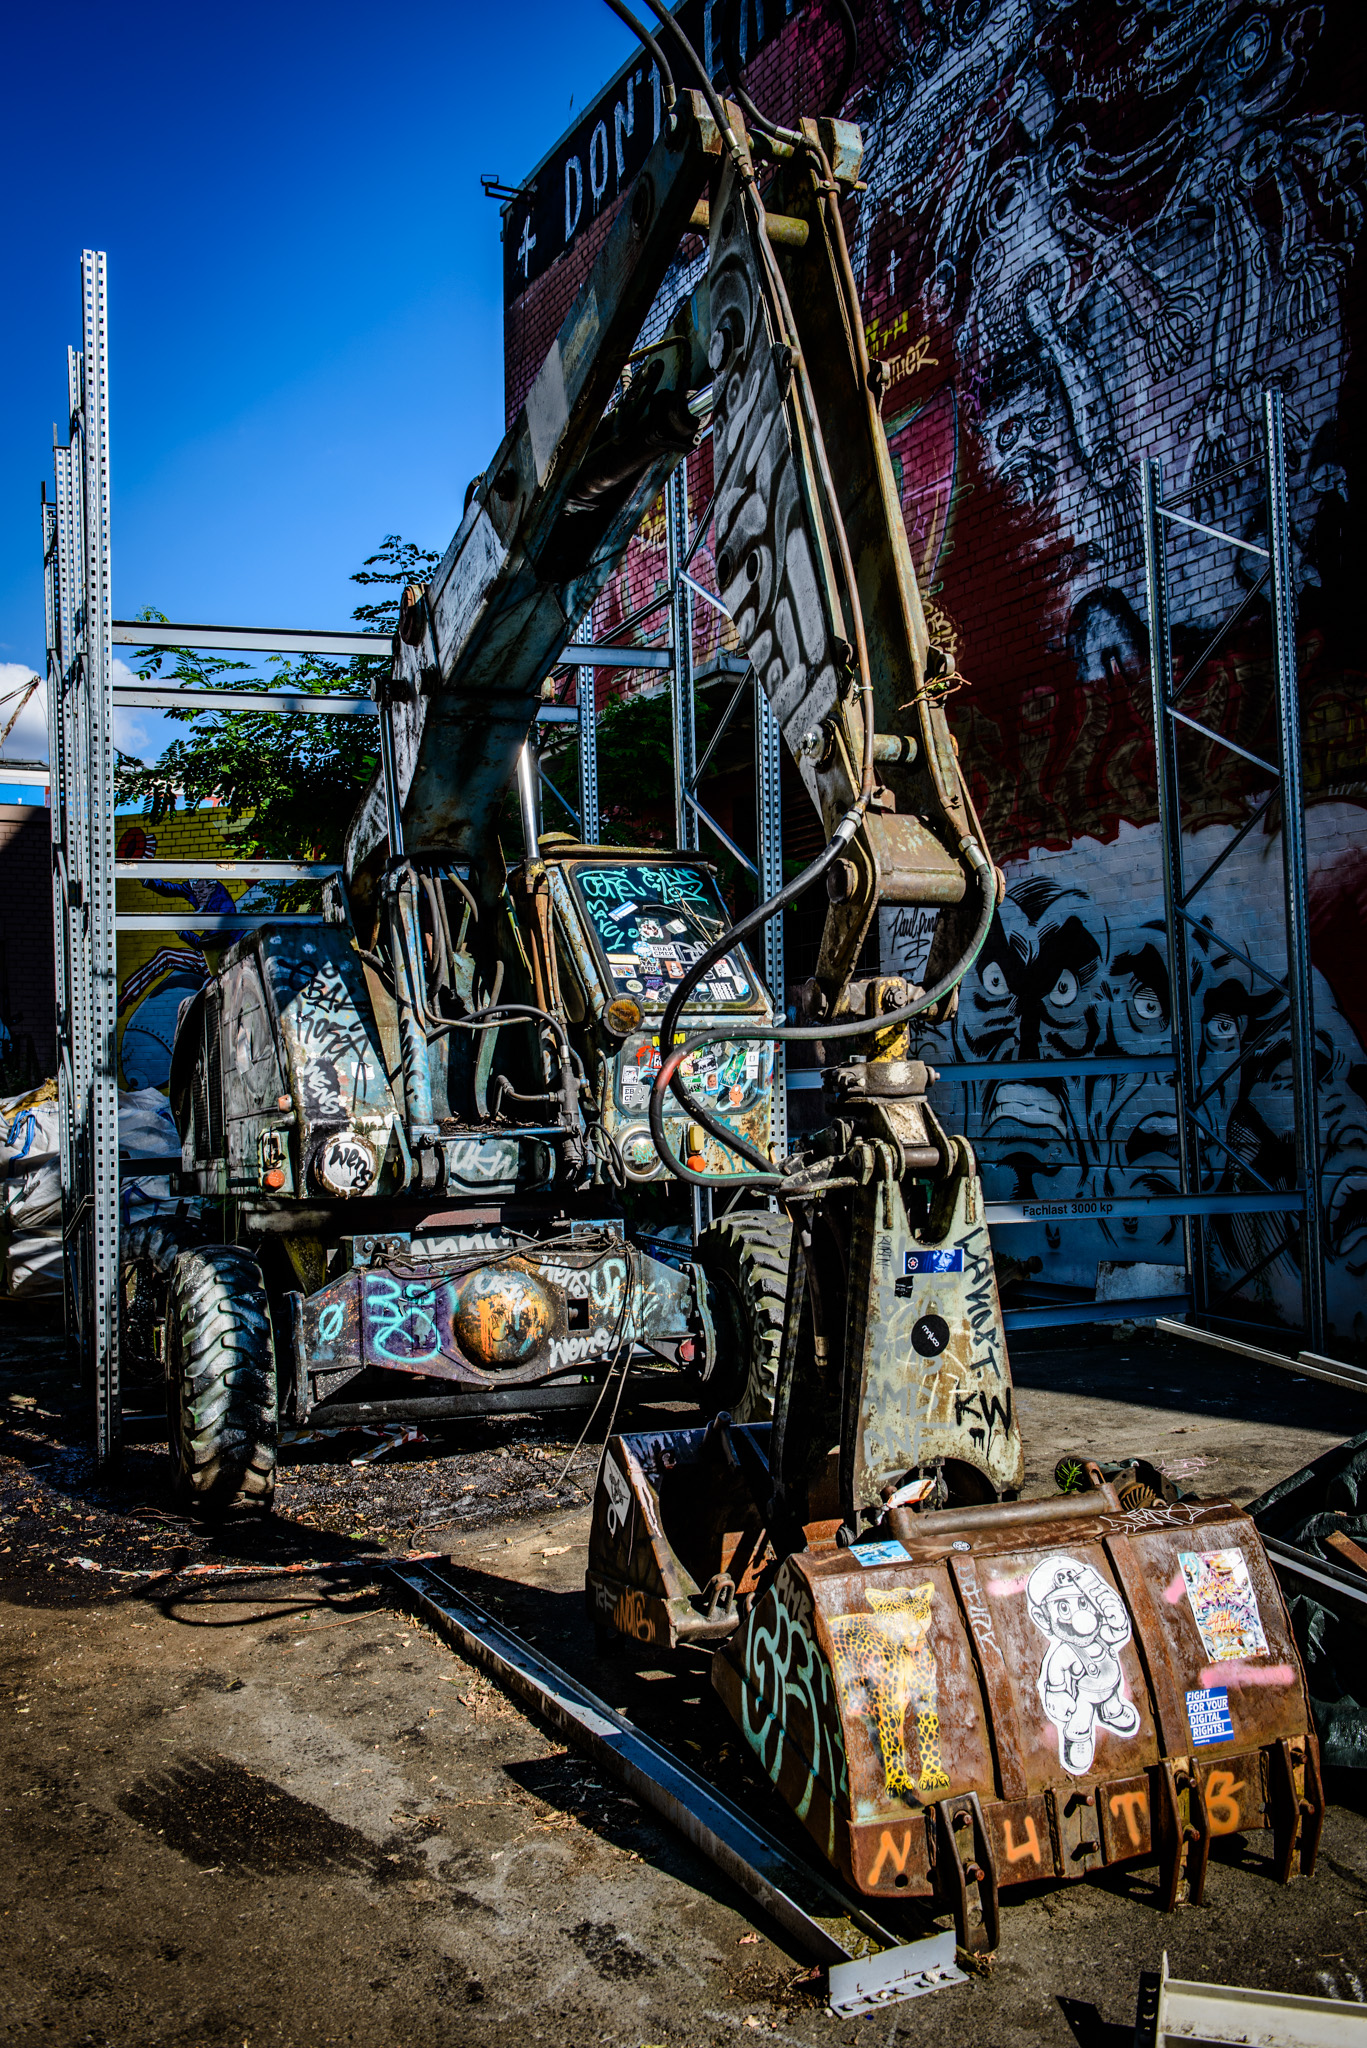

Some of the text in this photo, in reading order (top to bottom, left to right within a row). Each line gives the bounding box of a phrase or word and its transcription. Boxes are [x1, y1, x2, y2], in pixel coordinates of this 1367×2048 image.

[1022, 1202, 1113, 1216] Fachlast 3000 kp
[1187, 1689, 1210, 1701] FIGHT
[1189, 1699, 1227, 1713] FOR YOUR
[1190, 1712, 1221, 1725] DIGITAL
[1193, 1723, 1225, 1737] RIGHTS!
